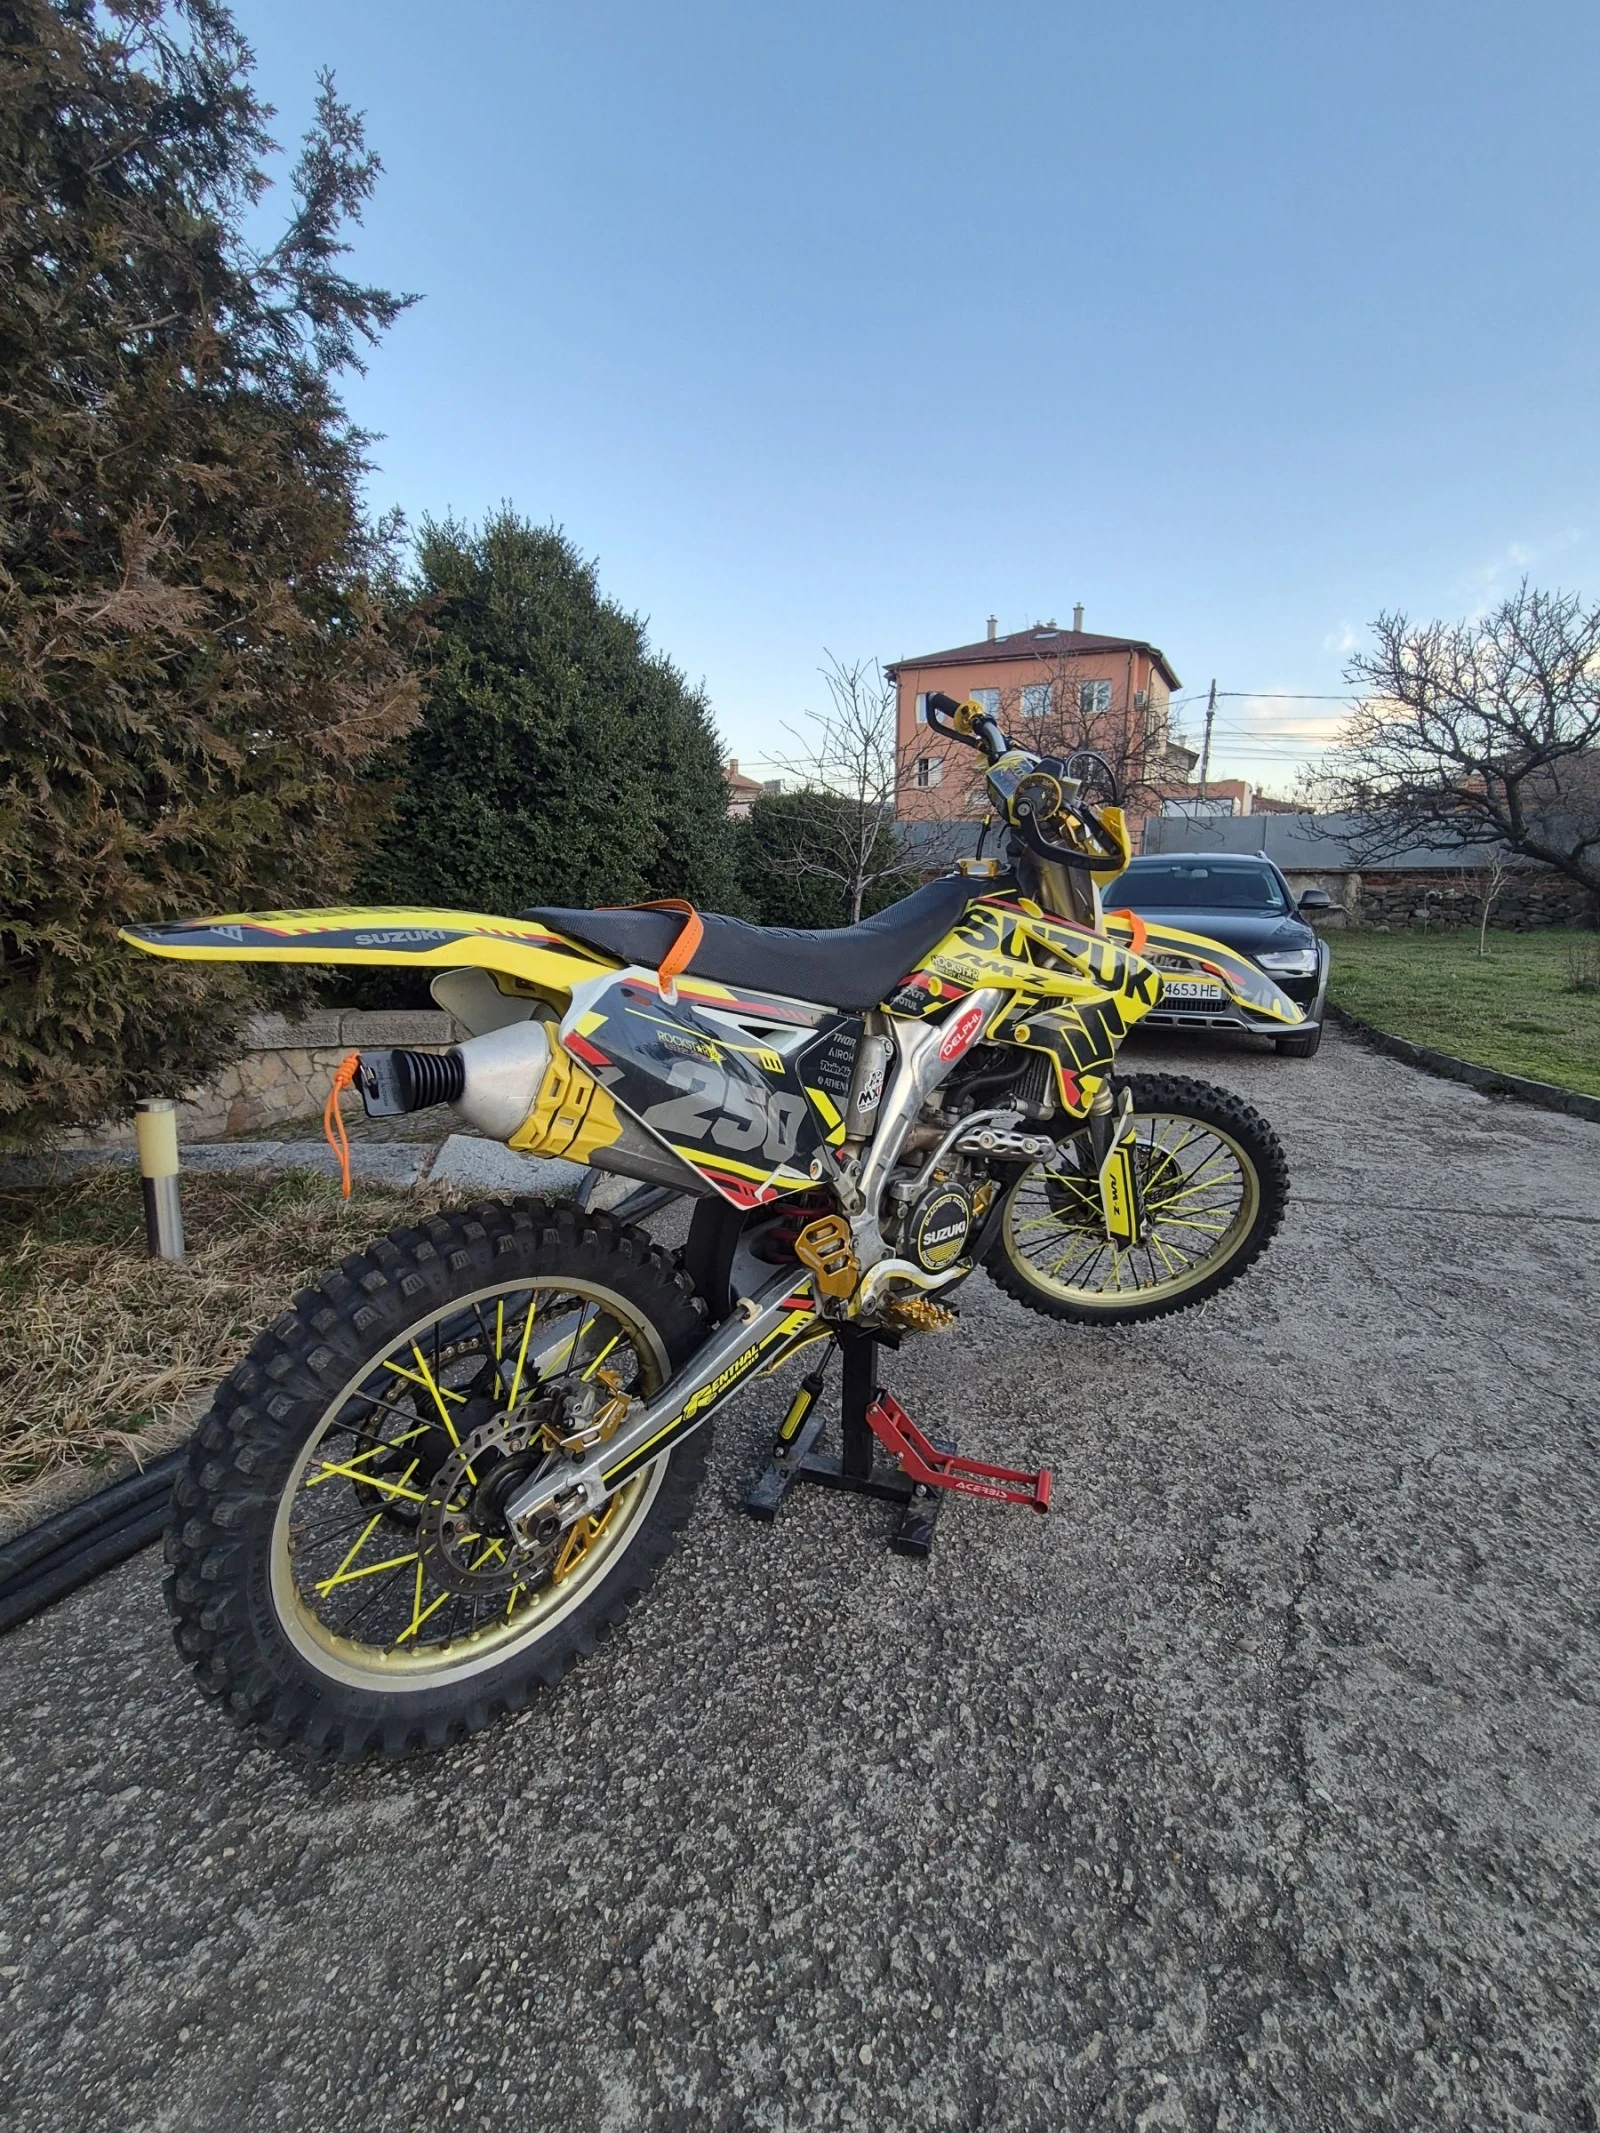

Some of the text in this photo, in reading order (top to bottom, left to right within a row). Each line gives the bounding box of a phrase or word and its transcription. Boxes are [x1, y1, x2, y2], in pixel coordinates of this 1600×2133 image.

[354, 930, 447, 946] SUZUKI
[953, 952, 1050, 987] RM-Z
[1145, 954, 1182, 970] ZUKI
[1165, 983, 1220, 997] 4653 HE
[833, 1033, 857, 1048] THOR
[943, 1013, 979, 1056] DELPHI
[828, 1047, 855, 1063] AIROH
[642, 1060, 808, 1163] 250
[1109, 1173, 1121, 1216] RM-Z
[922, 1220, 966, 1246] SUZUKI
[682, 1345, 759, 1421] RENTHAL
[955, 1481, 1008, 1499] ACERBIS
